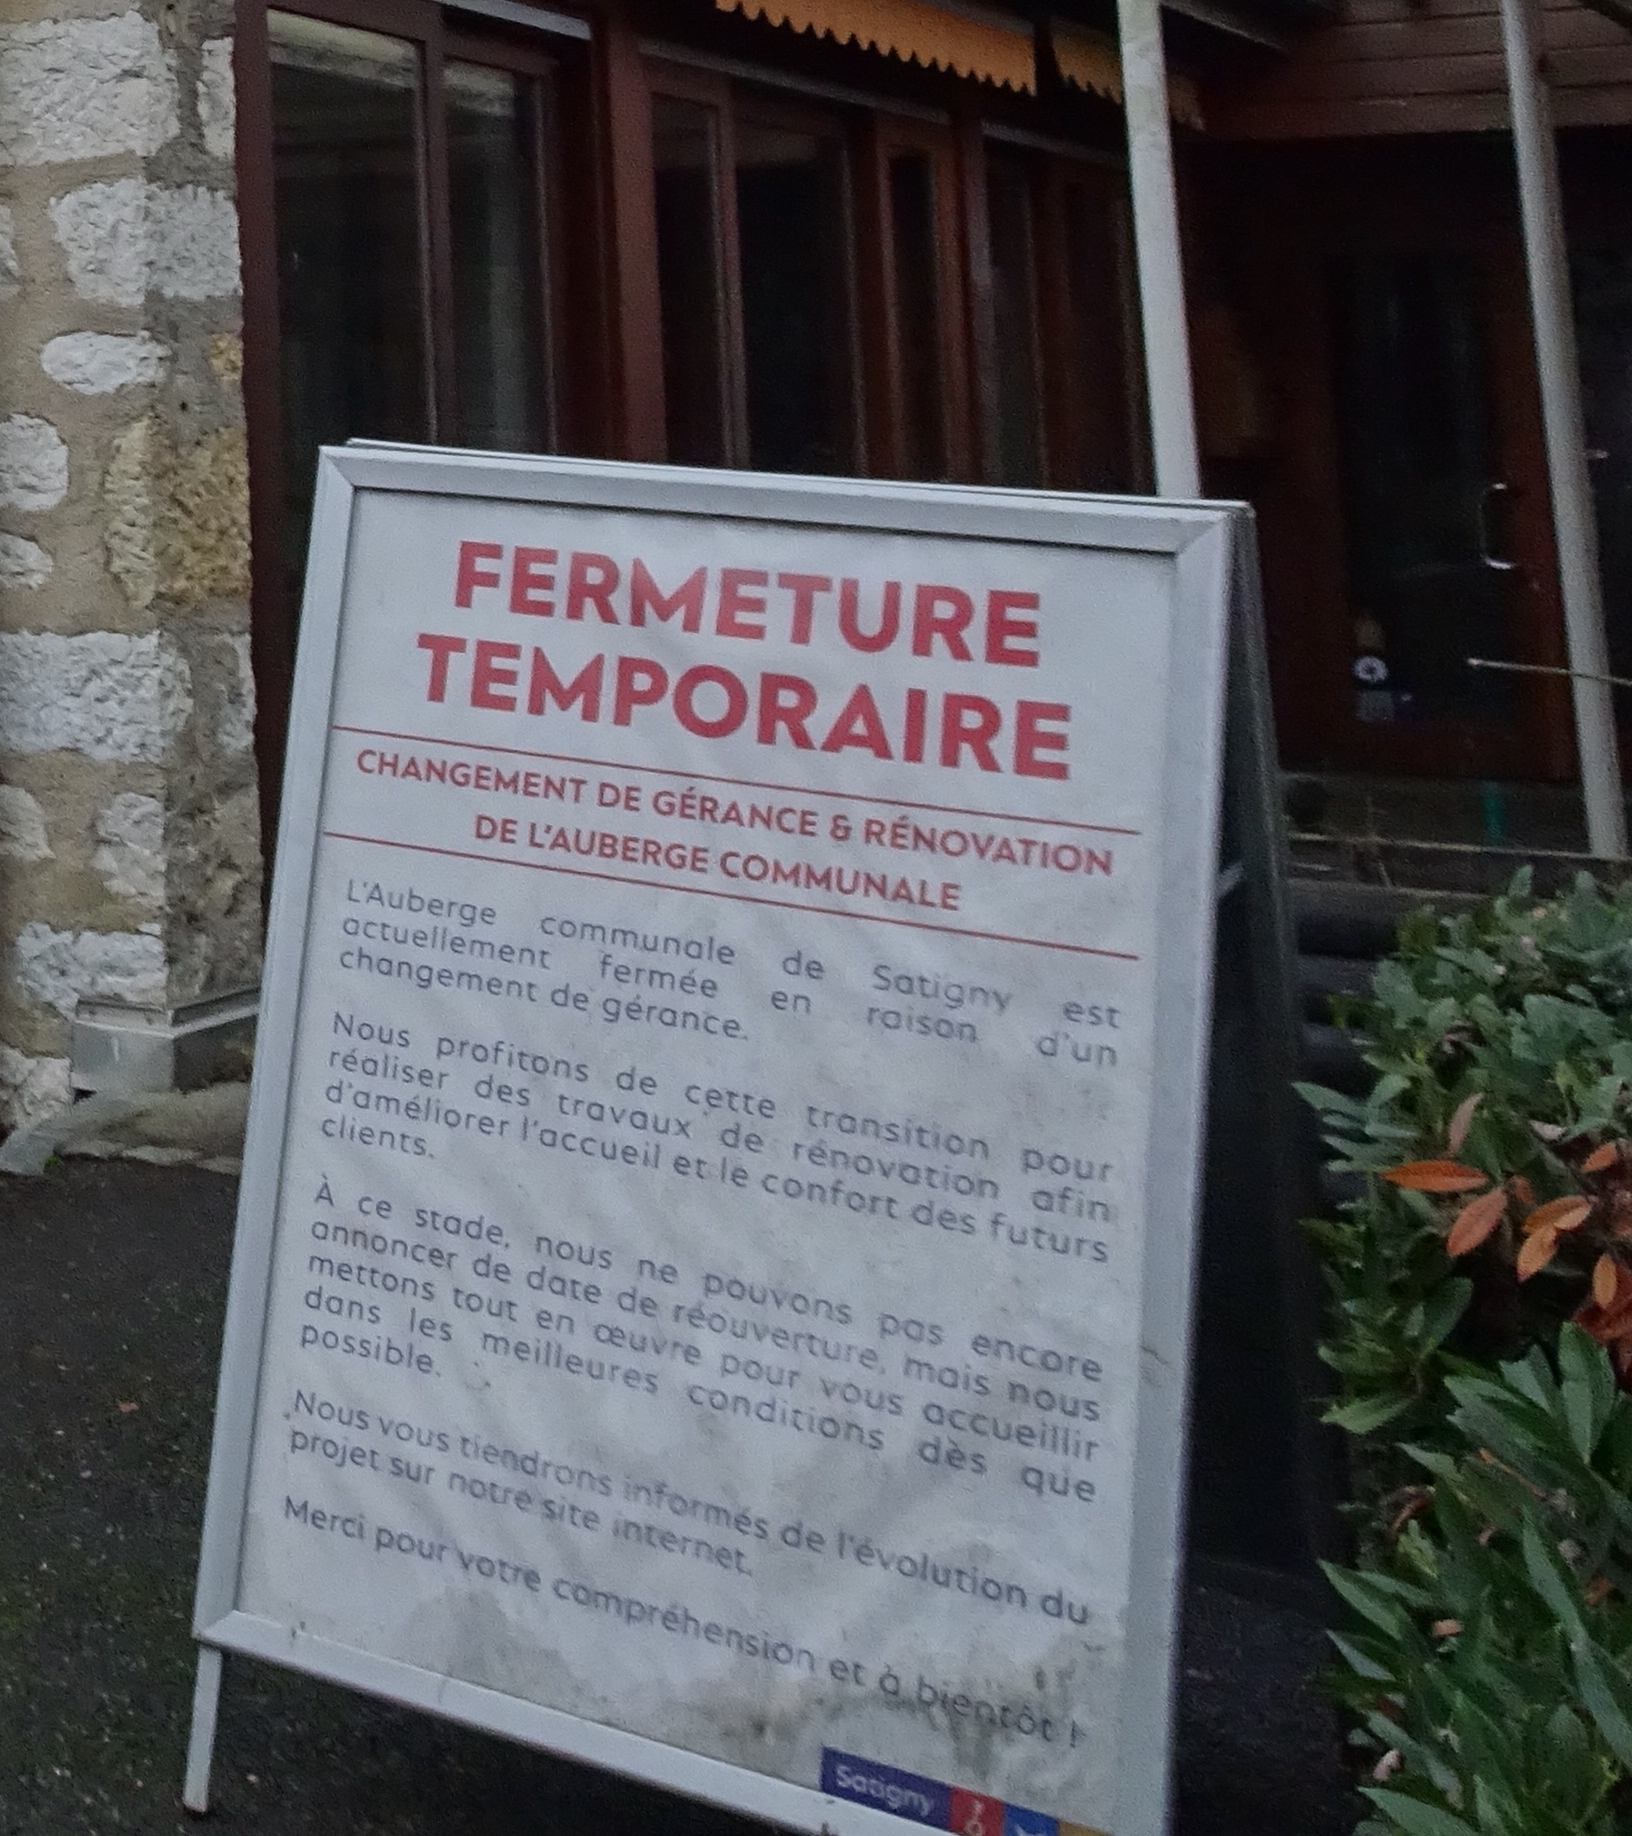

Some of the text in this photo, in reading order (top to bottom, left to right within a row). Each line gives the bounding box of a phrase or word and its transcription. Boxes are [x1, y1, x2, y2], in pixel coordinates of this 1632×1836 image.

[454, 541, 1038, 667] FERMETURE
[417, 633, 1069, 780] TEMPORAIRE
[356, 749, 1114, 876] CHANGEMENT DE GÉRANCE & RÉNOVATION
[474, 813, 962, 911] DE L'AUBERGE COMMUNALE
[339, 946, 748, 1041] changement de gérance.
[342, 918, 1117, 1068] actuellement fermée en raison d'un
[347, 879, 1121, 1029] L'Auberge communale de Satigny est
[320, 1116, 435, 1159] clients.
[325, 1079, 1108, 1263] d'améliorer l'accueil et le confort des futurs
[329, 1048, 1111, 1221] réaliser des travaux de rénovation afin
[333, 1011, 1113, 1181] Nous profitons de cette transition pour
[300, 1324, 441, 1377] possible.
[311, 1221, 1100, 1421] annoncer de date de réouverture, mais nous
[314, 1173, 1103, 1383] À ce stade, nous ne pouvons pas encore
[304, 1285, 1097, 1503] dans les meilleures conditions dès que
[308, 1255, 1099, 1461] mettons tout en œuvre pour vous accueillir
[289, 1428, 752, 1576] projet sur notre site internet.
[293, 1389, 1089, 1625] Nous vous tiendrons informés de l'évolution du
[284, 1495, 366, 1541] Merci
[374, 1526, 449, 1563] pour
[455, 1544, 541, 1592] votre
[552, 1578, 816, 1672] compréhension
[828, 1658, 867, 1688] et
[878, 1665, 901, 1698] à
[917, 1674, 1054, 1741] bientôt
